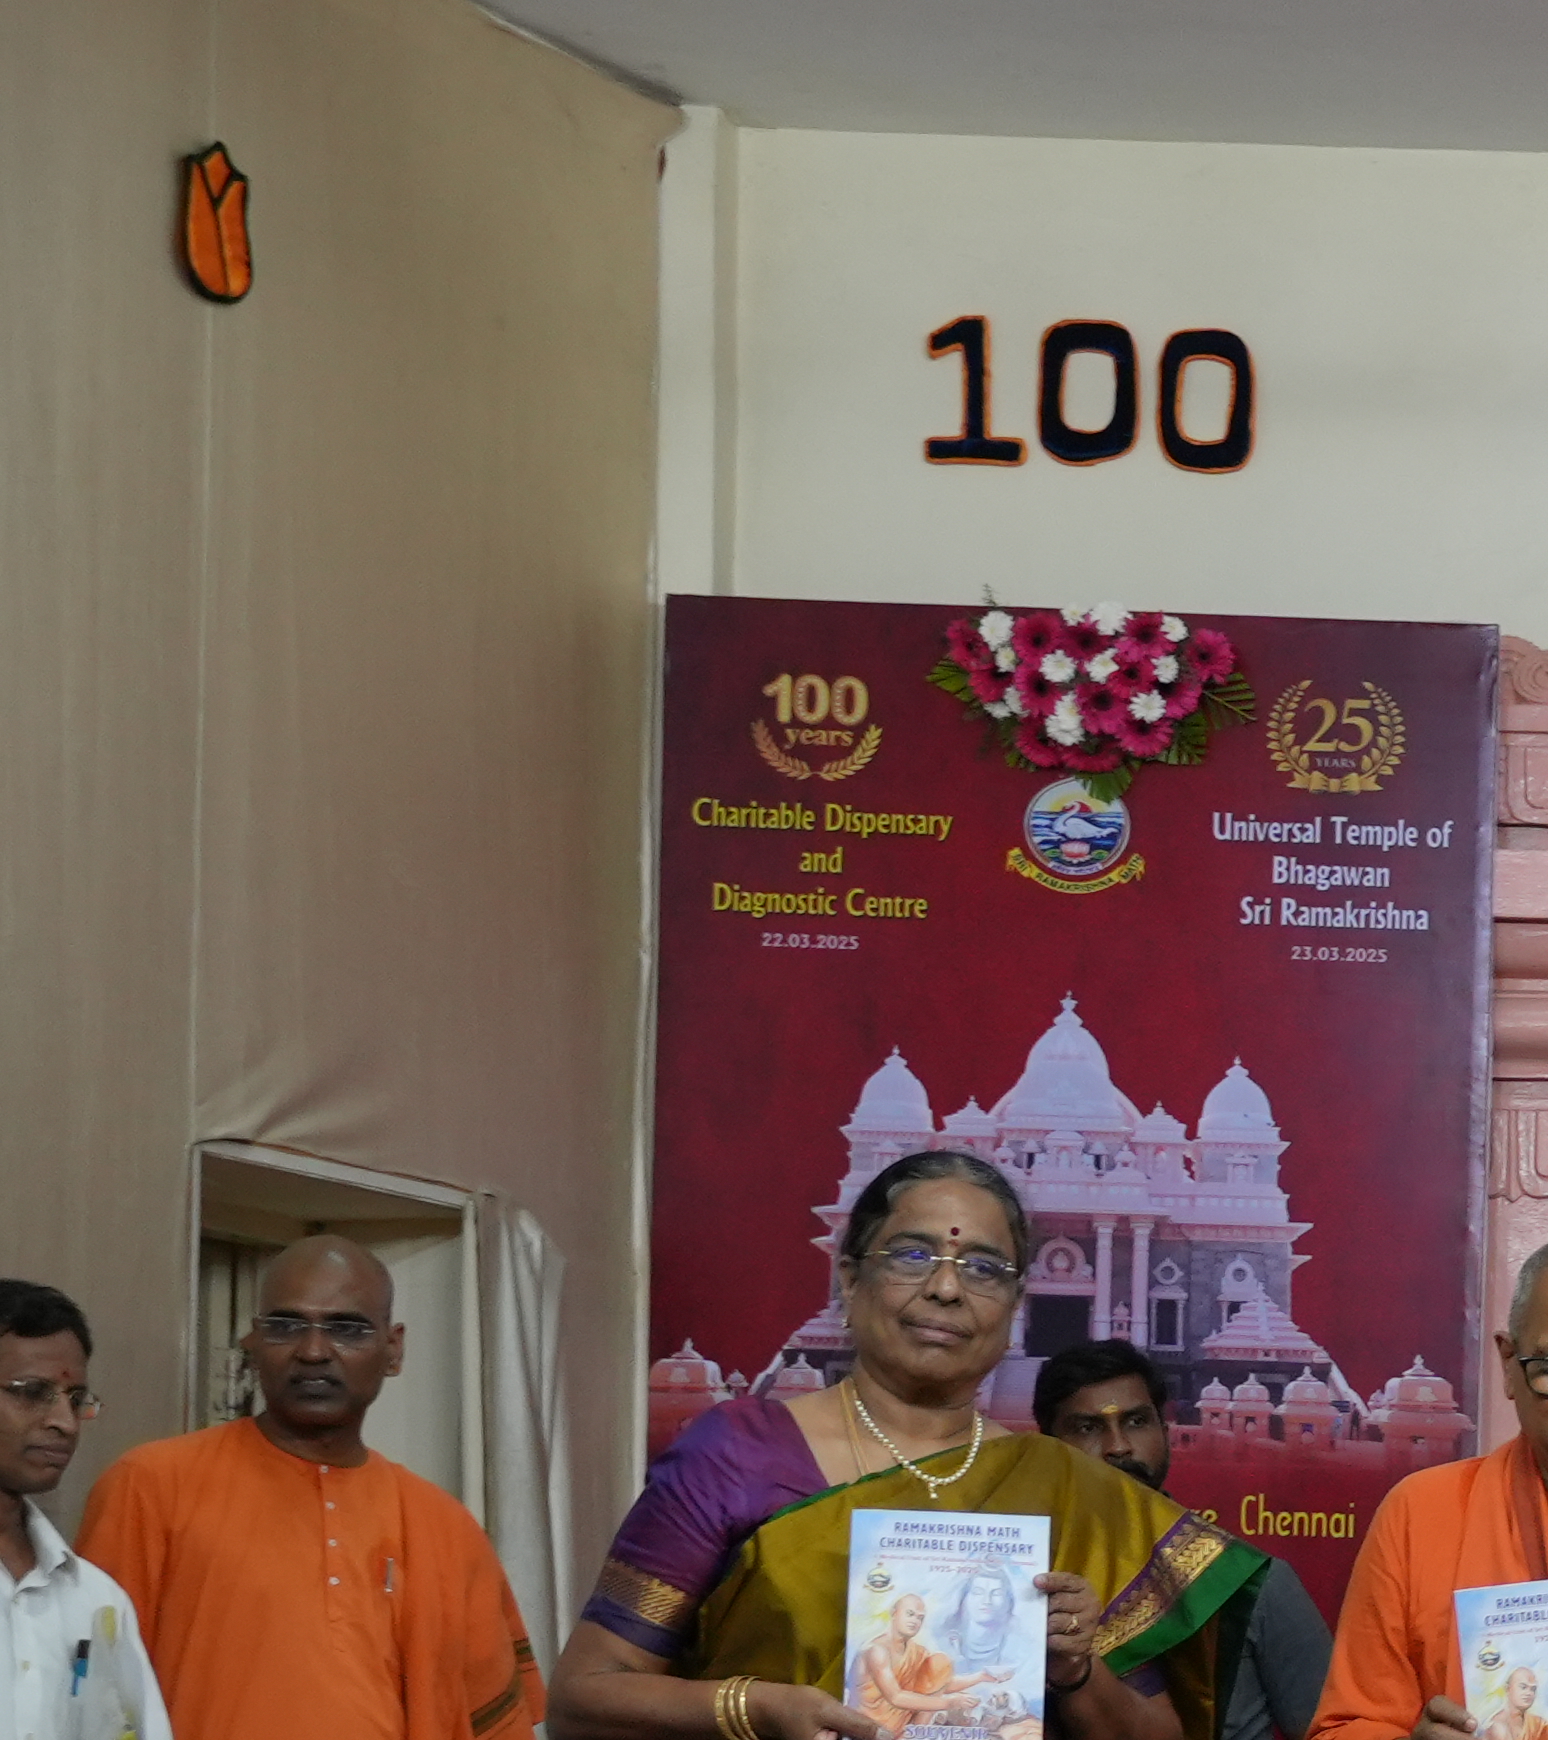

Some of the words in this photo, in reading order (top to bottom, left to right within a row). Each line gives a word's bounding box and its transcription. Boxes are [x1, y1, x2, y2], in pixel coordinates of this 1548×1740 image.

[924, 314, 1257, 474] 100
[762, 673, 869, 726] 100
[784, 727, 855, 749] years
[1301, 698, 1374, 753] 25
[1315, 757, 1357, 769] YEARS
[691, 797, 816, 831] Charitable
[825, 803, 953, 841] Dispensary
[1212, 811, 1322, 844] Universal
[1330, 816, 1418, 851] Temple
[1426, 820, 1454, 848] of
[799, 847, 844, 874] and
[1272, 855, 1390, 891] Bhagawan
[712, 882, 837, 918] Diagnostic
[846, 888, 929, 919] Centre
[1239, 896, 1271, 925] Sri
[1280, 898, 1429, 931] Ramakrishna
[761, 932, 859, 950] 22.03.2025
[1291, 945, 1388, 963] 23.03.2025
[894, 1522, 982, 1536] RAMAKRISHNA
[986, 1525, 1021, 1538] MATH
[1240, 1493, 1356, 1538] Chennai
[879, 1537, 954, 1551] CHARITABLE
[958, 1540, 1035, 1555] DISPENSARY
